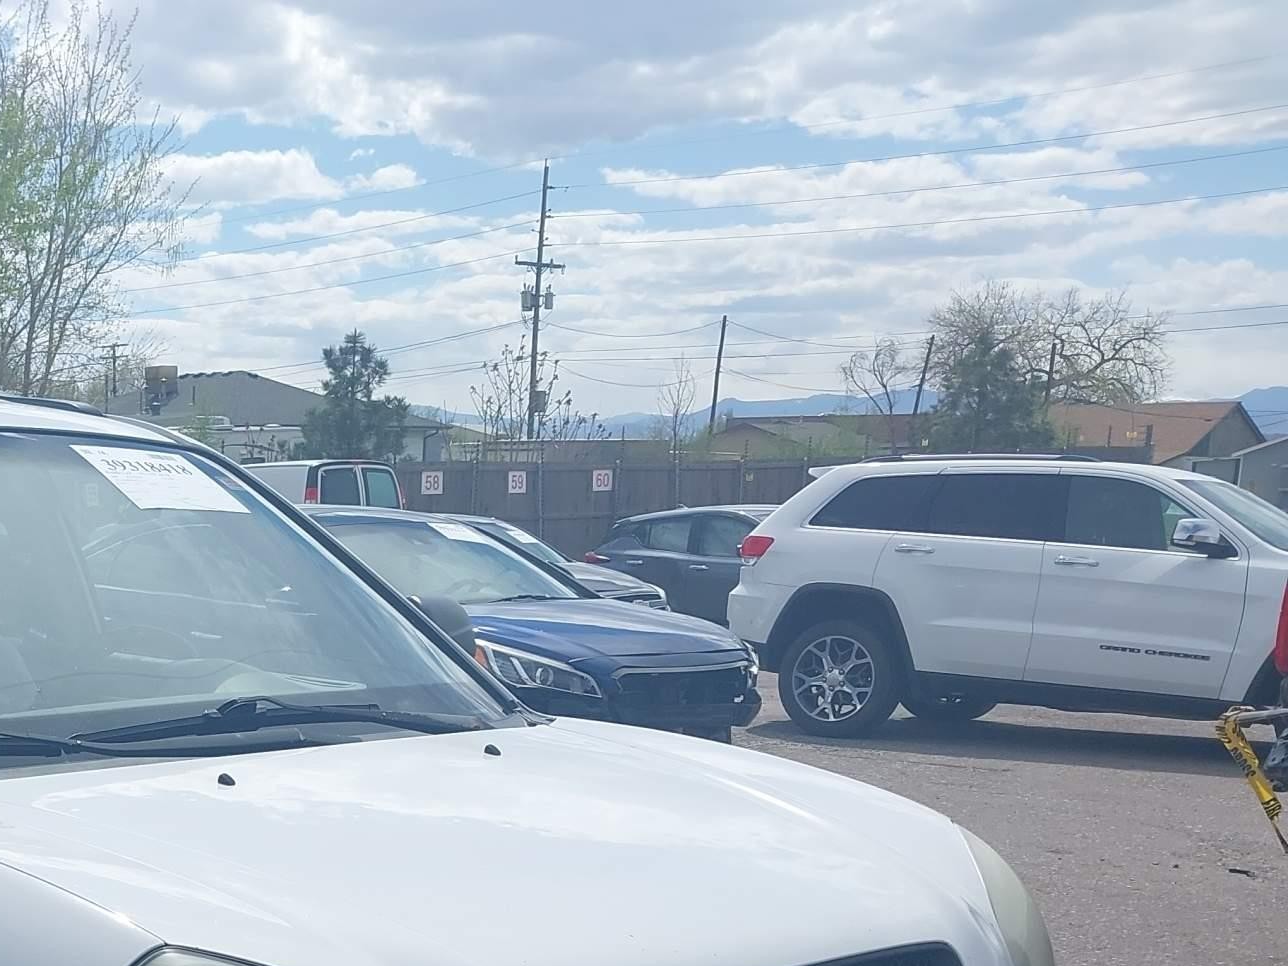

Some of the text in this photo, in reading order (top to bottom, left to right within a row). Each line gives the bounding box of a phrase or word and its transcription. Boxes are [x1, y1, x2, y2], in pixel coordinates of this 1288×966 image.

[101, 459, 193, 476] 39318418
[425, 475, 440, 490] 58
[511, 474, 524, 490] 59
[596, 472, 610, 488] 60
[1099, 644, 1211, 661] GRAND CHEROKEE
